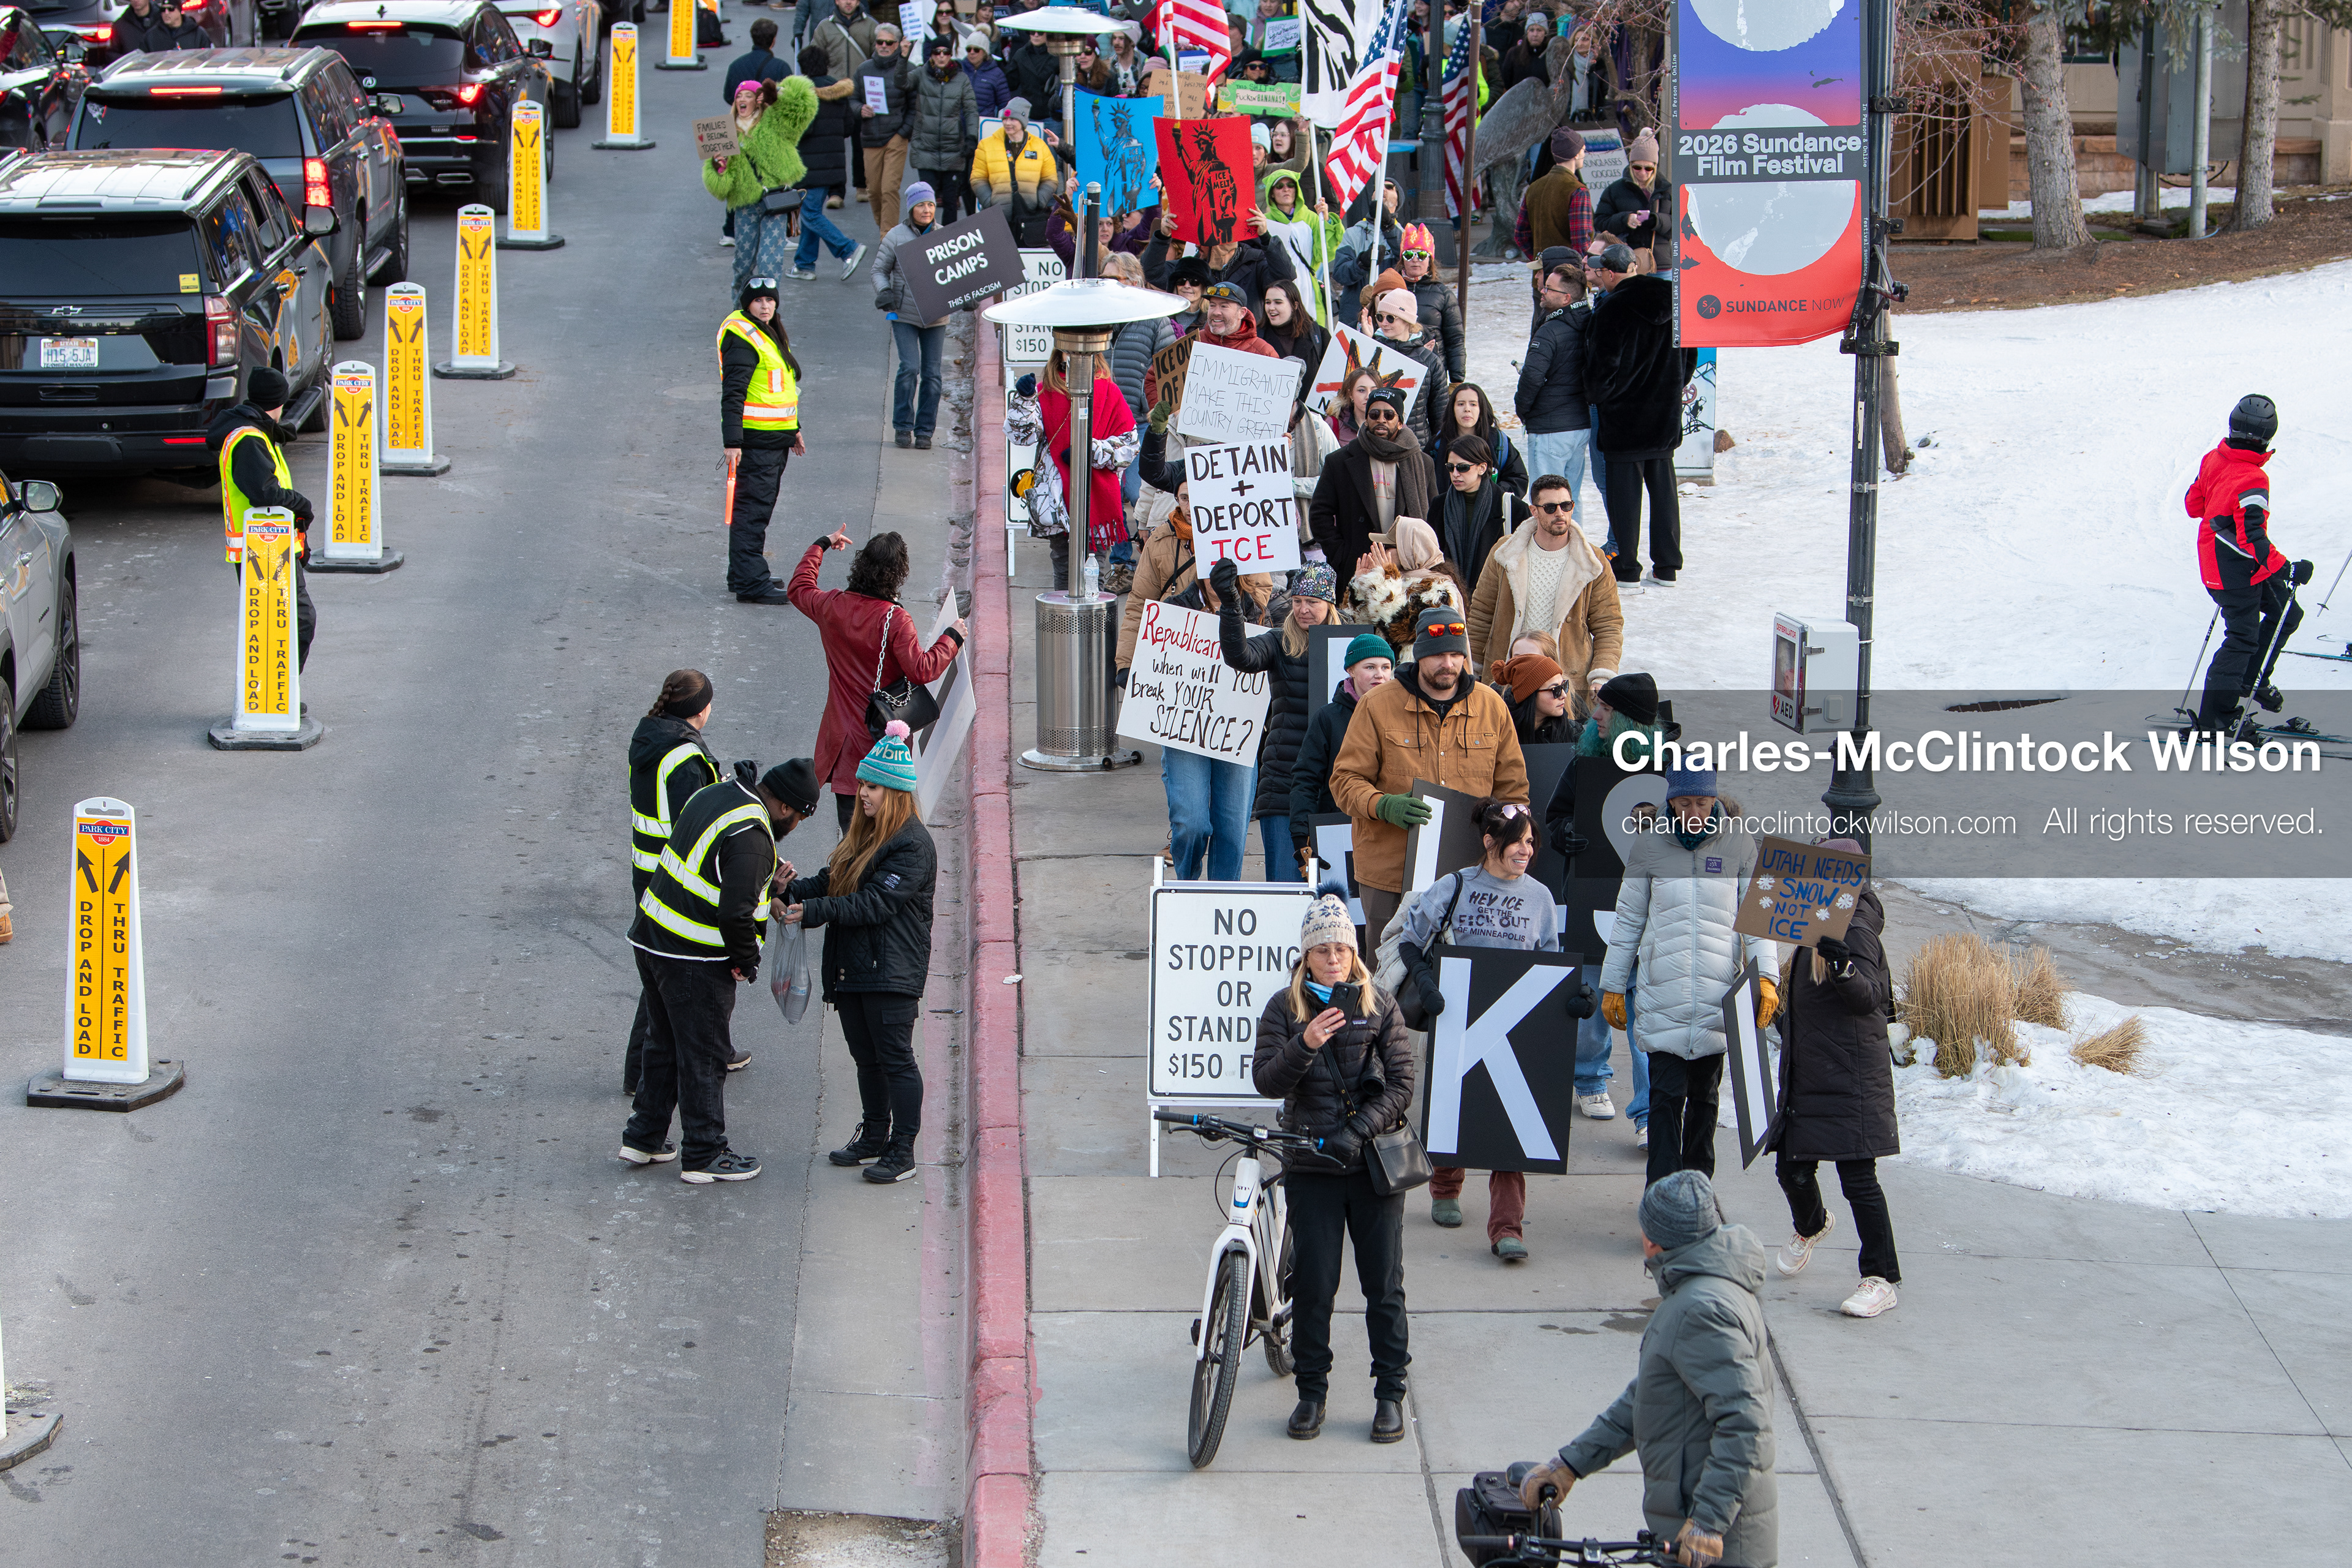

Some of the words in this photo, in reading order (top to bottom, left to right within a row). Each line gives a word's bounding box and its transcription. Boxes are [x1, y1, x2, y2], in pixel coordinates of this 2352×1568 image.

[1250, 83, 1268, 92] SHIT
[696, 121, 726, 133] FAMILIES
[707, 132, 728, 140] BELONG
[701, 141, 735, 153] TOGETHER
[1679, 134, 1738, 155] 2026
[1743, 132, 1861, 154] Sundance
[1126, 154, 1141, 164] MELT
[1583, 157, 1623, 167] SUNGLASSES
[1591, 169, 1621, 178] GOGGLES
[1697, 156, 1747, 176] Film
[1753, 153, 1843, 175] Festival
[1213, 179, 1231, 190] MELT
[1215, 172, 1226, 181] ICE
[925, 228, 985, 265] PRISON
[935, 252, 989, 285] CAMPS
[1038, 262, 1063, 276] NO
[948, 298, 963, 308] THIS
[964, 293, 971, 302] IS
[971, 281, 1002, 299] FASCISM
[1726, 300, 1807, 313] SUNDANCE
[1812, 298, 1845, 311] NOW
[1016, 338, 1047, 352] $150
[1155, 348, 1175, 380] ICE
[1176, 334, 1197, 366] OUT
[391, 349, 399, 381] DROP
[1188, 355, 1295, 398] IMMIGRANTS
[1161, 375, 1178, 405] OF
[1186, 381, 1226, 407] MAKE
[1235, 393, 1272, 415] THIS
[391, 414, 399, 447] LOAD
[413, 390, 421, 447] TRAFFIC
[1183, 407, 1232, 432] COUNTRY
[336, 434, 345, 469] DROP
[360, 434, 369, 469] THRU
[1191, 444, 1287, 481] DETAIN
[336, 473, 345, 500] AND
[336, 505, 345, 540] LOAD
[360, 478, 368, 541] TRAFFIC
[1194, 497, 1292, 533] DEPORT
[1210, 534, 1274, 565] ICE
[249, 588, 260, 628] DROP
[276, 588, 287, 628] THRU
[1776, 622, 1796, 639] DEFIBRILLATOR
[249, 634, 259, 663] AND
[276, 639, 286, 711] TRAFFIC
[1153, 651, 1183, 676] when
[1191, 664, 1221, 684] will
[1232, 669, 1266, 695] YOU
[248, 669, 259, 710] LOAD
[1131, 671, 1165, 702] break
[1174, 680, 1215, 714] YOUR
[1780, 700, 1793, 719] AED
[1150, 704, 1254, 757] SILENCE?
[81, 824, 103, 834] PARK
[105, 826, 127, 834] CITY
[1762, 848, 1806, 876] UTAH
[1813, 856, 1867, 887] NEEDS
[1469, 891, 1499, 907] HEY
[1501, 895, 1525, 911] ICE
[1779, 877, 1840, 907] SNOW
[1214, 908, 1257, 936] NO
[1496, 909, 1512, 918] THE
[1499, 916, 1530, 929] OUT
[1774, 902, 1812, 919] NOT
[80, 901, 93, 952] DROP
[113, 903, 126, 954] THRU
[1470, 928, 1526, 942] MINNEAPOLIS
[1768, 916, 1809, 940] ICE
[79, 959, 92, 996] AND
[1216, 980, 1252, 1008] OR
[111, 967, 126, 1058] TRAFFIC
[78, 1003, 92, 1054] LOAD
[1168, 1053, 1223, 1079] $150
[1427, 957, 1575, 1161] K
